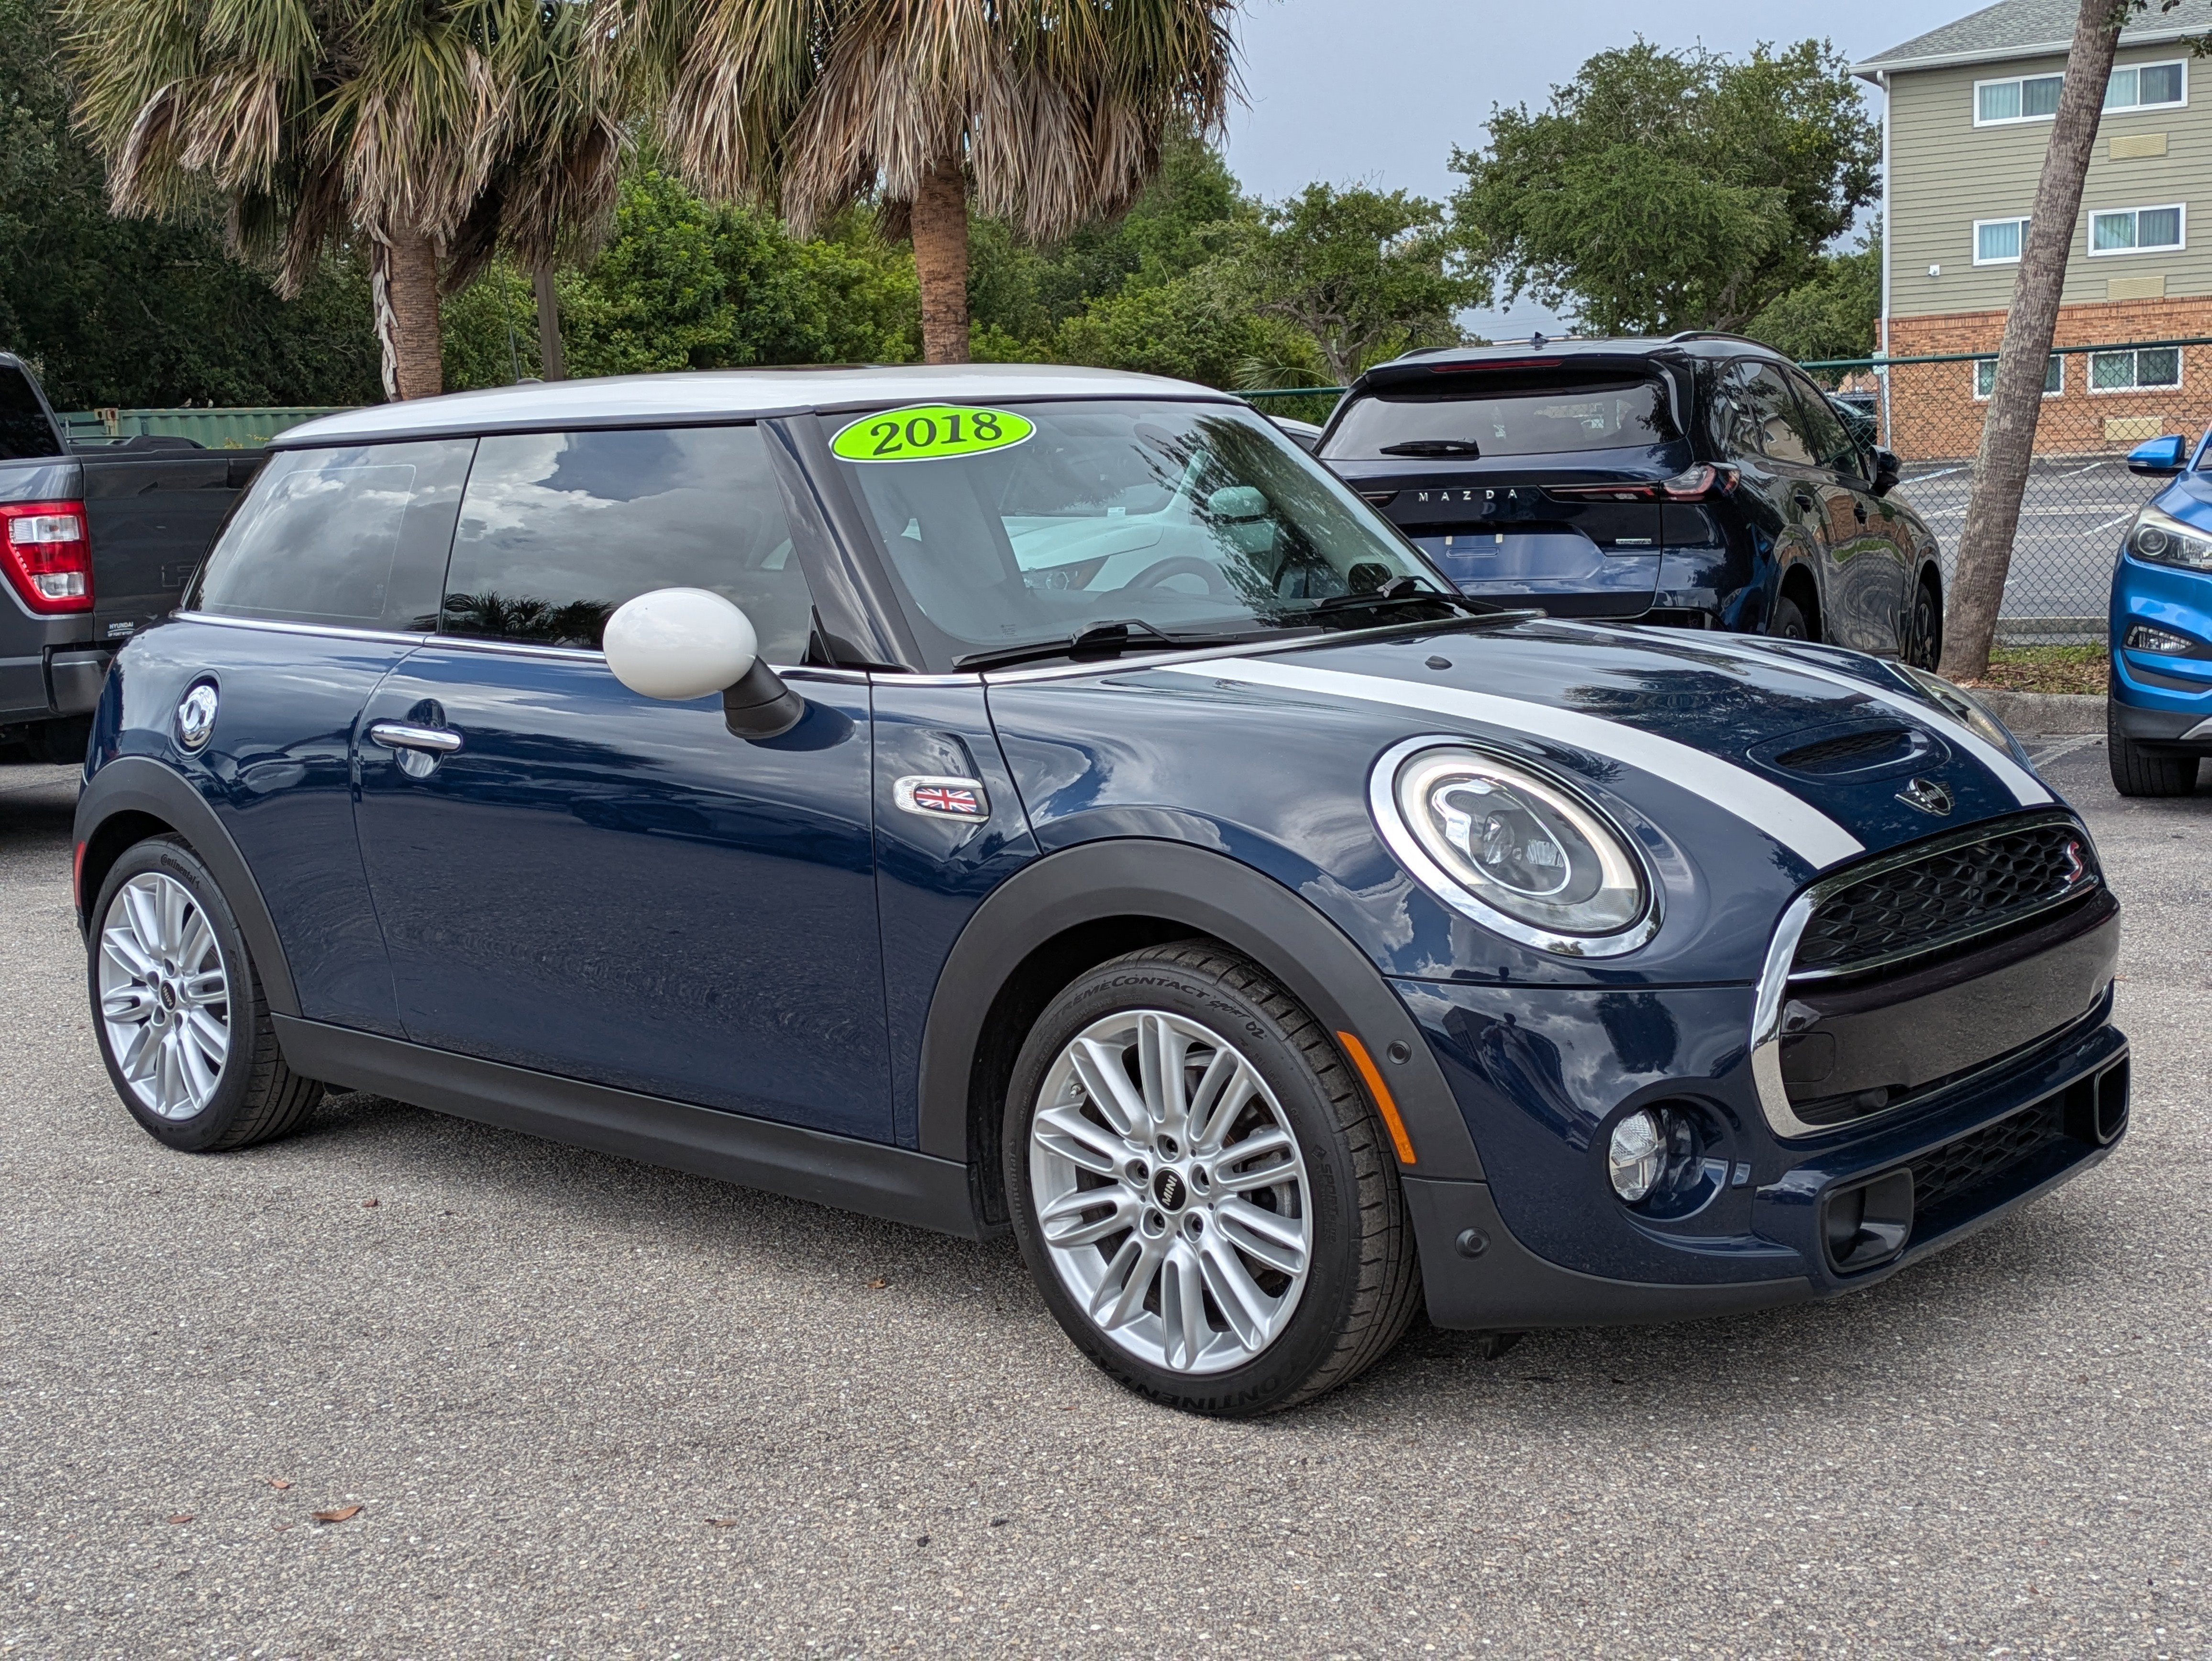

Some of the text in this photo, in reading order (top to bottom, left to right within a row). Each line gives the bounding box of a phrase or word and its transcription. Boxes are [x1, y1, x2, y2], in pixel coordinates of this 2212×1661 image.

[870, 412, 1003, 455] 2018
[1418, 489, 1517, 502] MAZDA
[161, 853, 196, 885] Continental
[163, 986, 173, 1006] MINI
[1204, 1000, 1250, 1019] SPORT
[1245, 1021, 1264, 1040] 02
[1162, 1175, 1177, 1206] MINI
